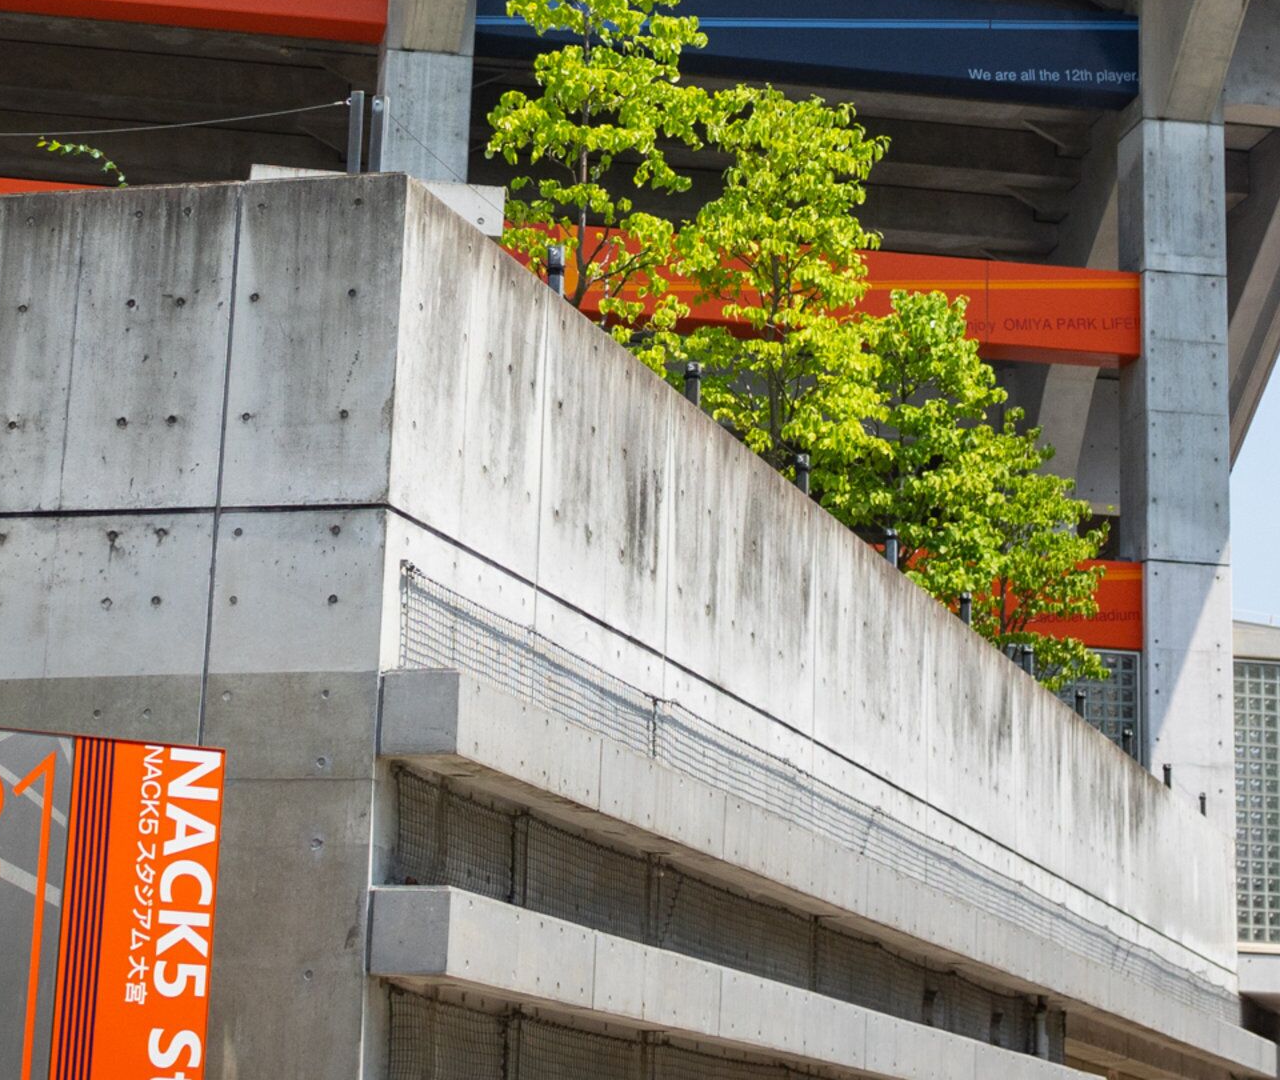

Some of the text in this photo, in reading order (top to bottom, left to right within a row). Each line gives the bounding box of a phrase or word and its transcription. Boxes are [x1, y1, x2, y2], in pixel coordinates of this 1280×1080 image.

[968, 69, 1139, 85] We are all the 12th player.
[966, 320, 996, 335] njoy
[1003, 318, 1052, 332] OMIYA
[1055, 318, 1096, 331] PARK
[138, 745, 164, 835] NACK5
[147, 747, 222, 1080] NACK5 S
